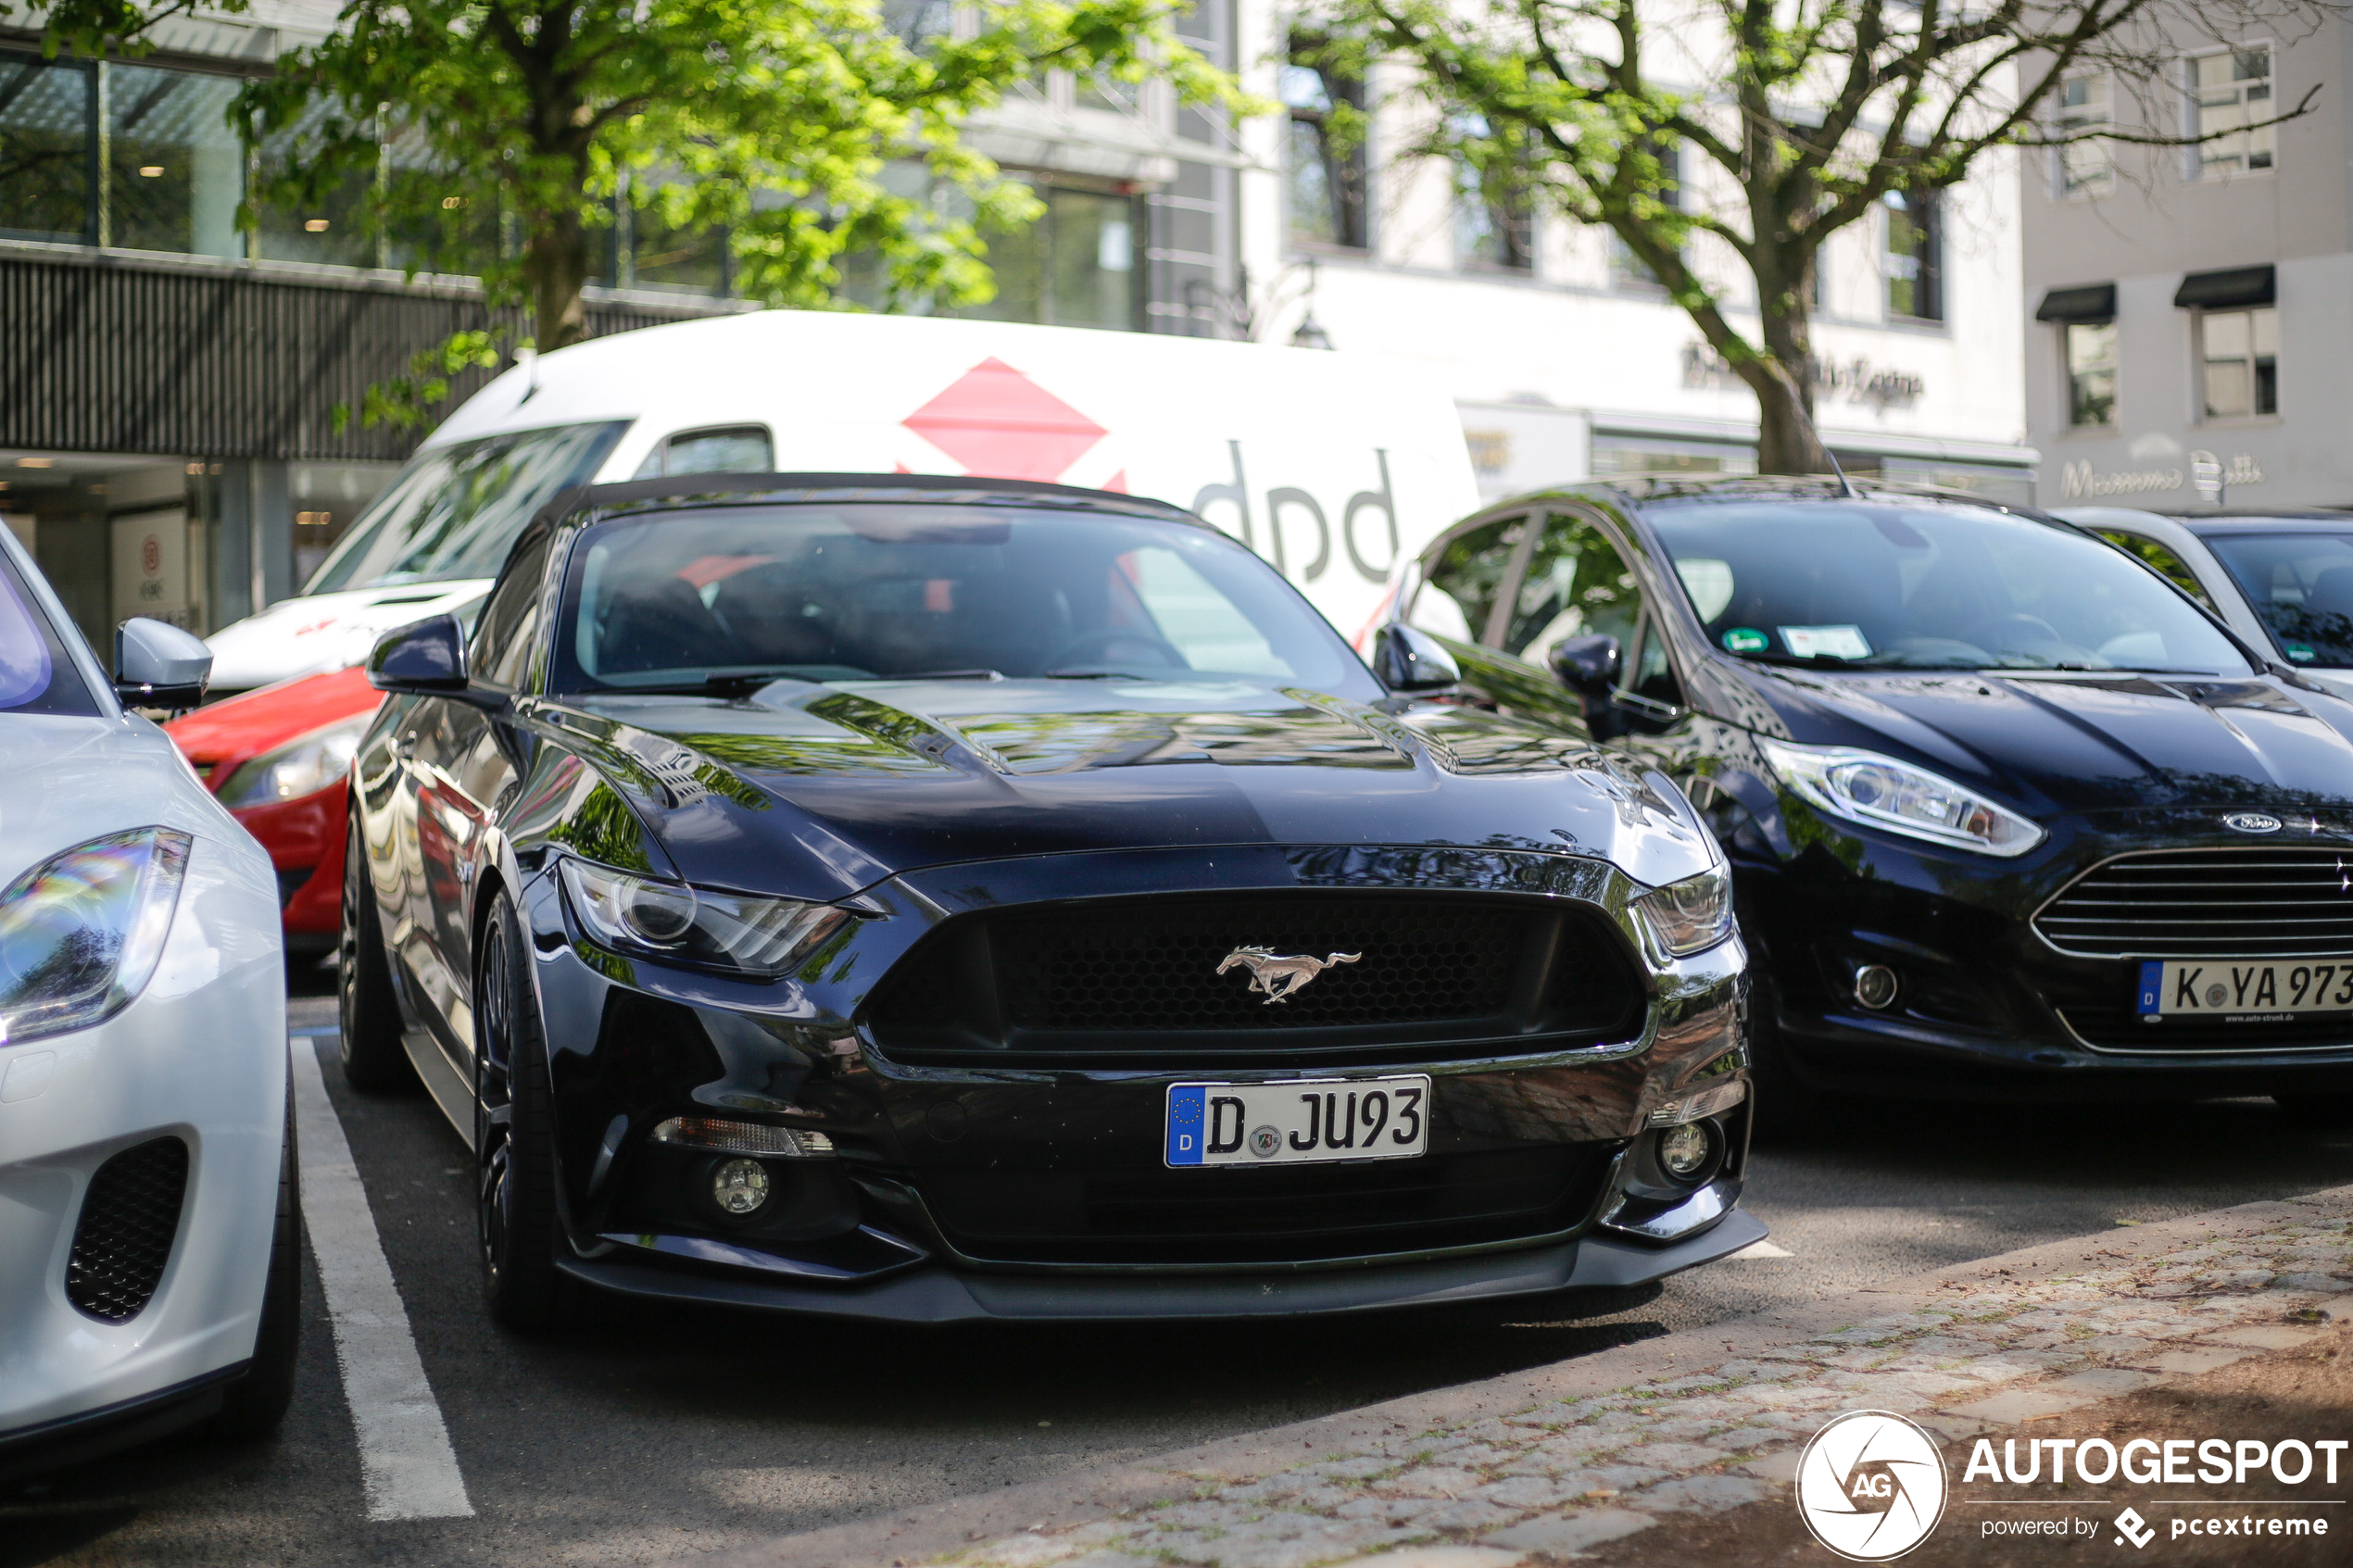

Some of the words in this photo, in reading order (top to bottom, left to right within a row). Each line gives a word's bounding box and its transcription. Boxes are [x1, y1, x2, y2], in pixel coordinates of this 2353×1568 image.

[2061, 459, 2183, 499] Massimo
[1192, 440, 1398, 583] dpd
[2144, 992, 2153, 1006] D
[2176, 967, 2203, 1009] K
[2232, 966, 2277, 1008] YA
[2289, 965, 2353, 1007] 973
[1206, 1096, 1246, 1154] D
[1289, 1087, 1422, 1151] JU93
[1179, 1134, 1192, 1151] D
